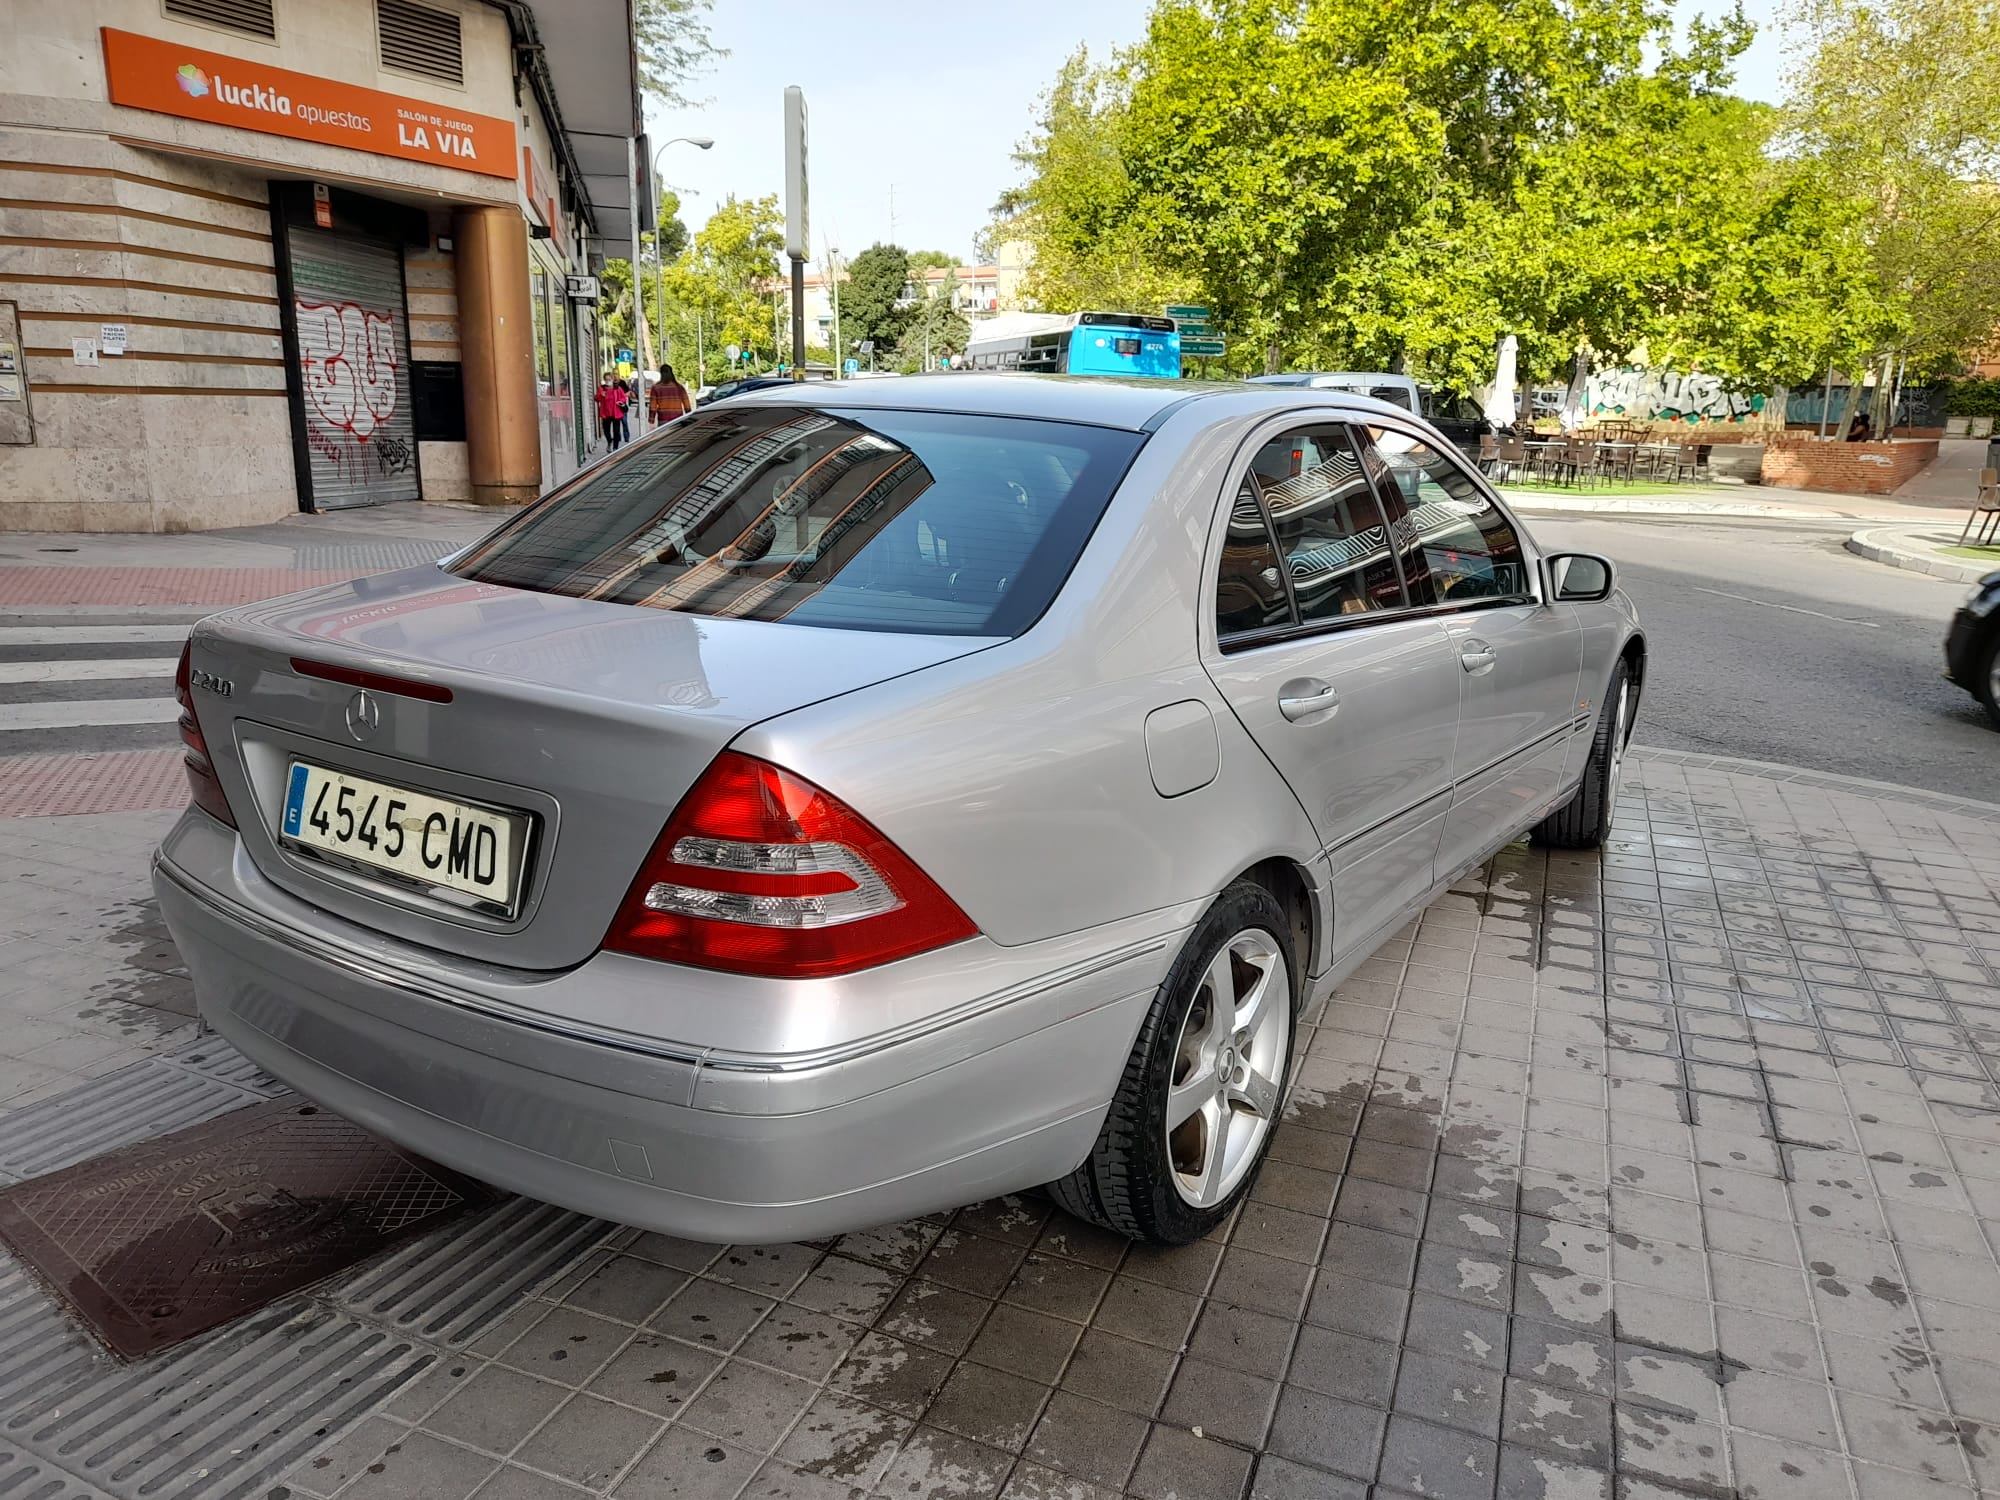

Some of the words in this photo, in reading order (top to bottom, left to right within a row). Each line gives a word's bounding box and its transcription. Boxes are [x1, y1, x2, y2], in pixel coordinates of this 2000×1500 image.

[213, 75, 292, 116] luckia
[296, 104, 372, 133] apuestas
[398, 123, 431, 150] LA
[436, 130, 477, 160] VIA
[430, 116, 443, 128] DE
[444, 119, 474, 133] JUEGO
[288, 807, 299, 823] E
[309, 781, 407, 858] 4545
[421, 812, 497, 886] CMD
